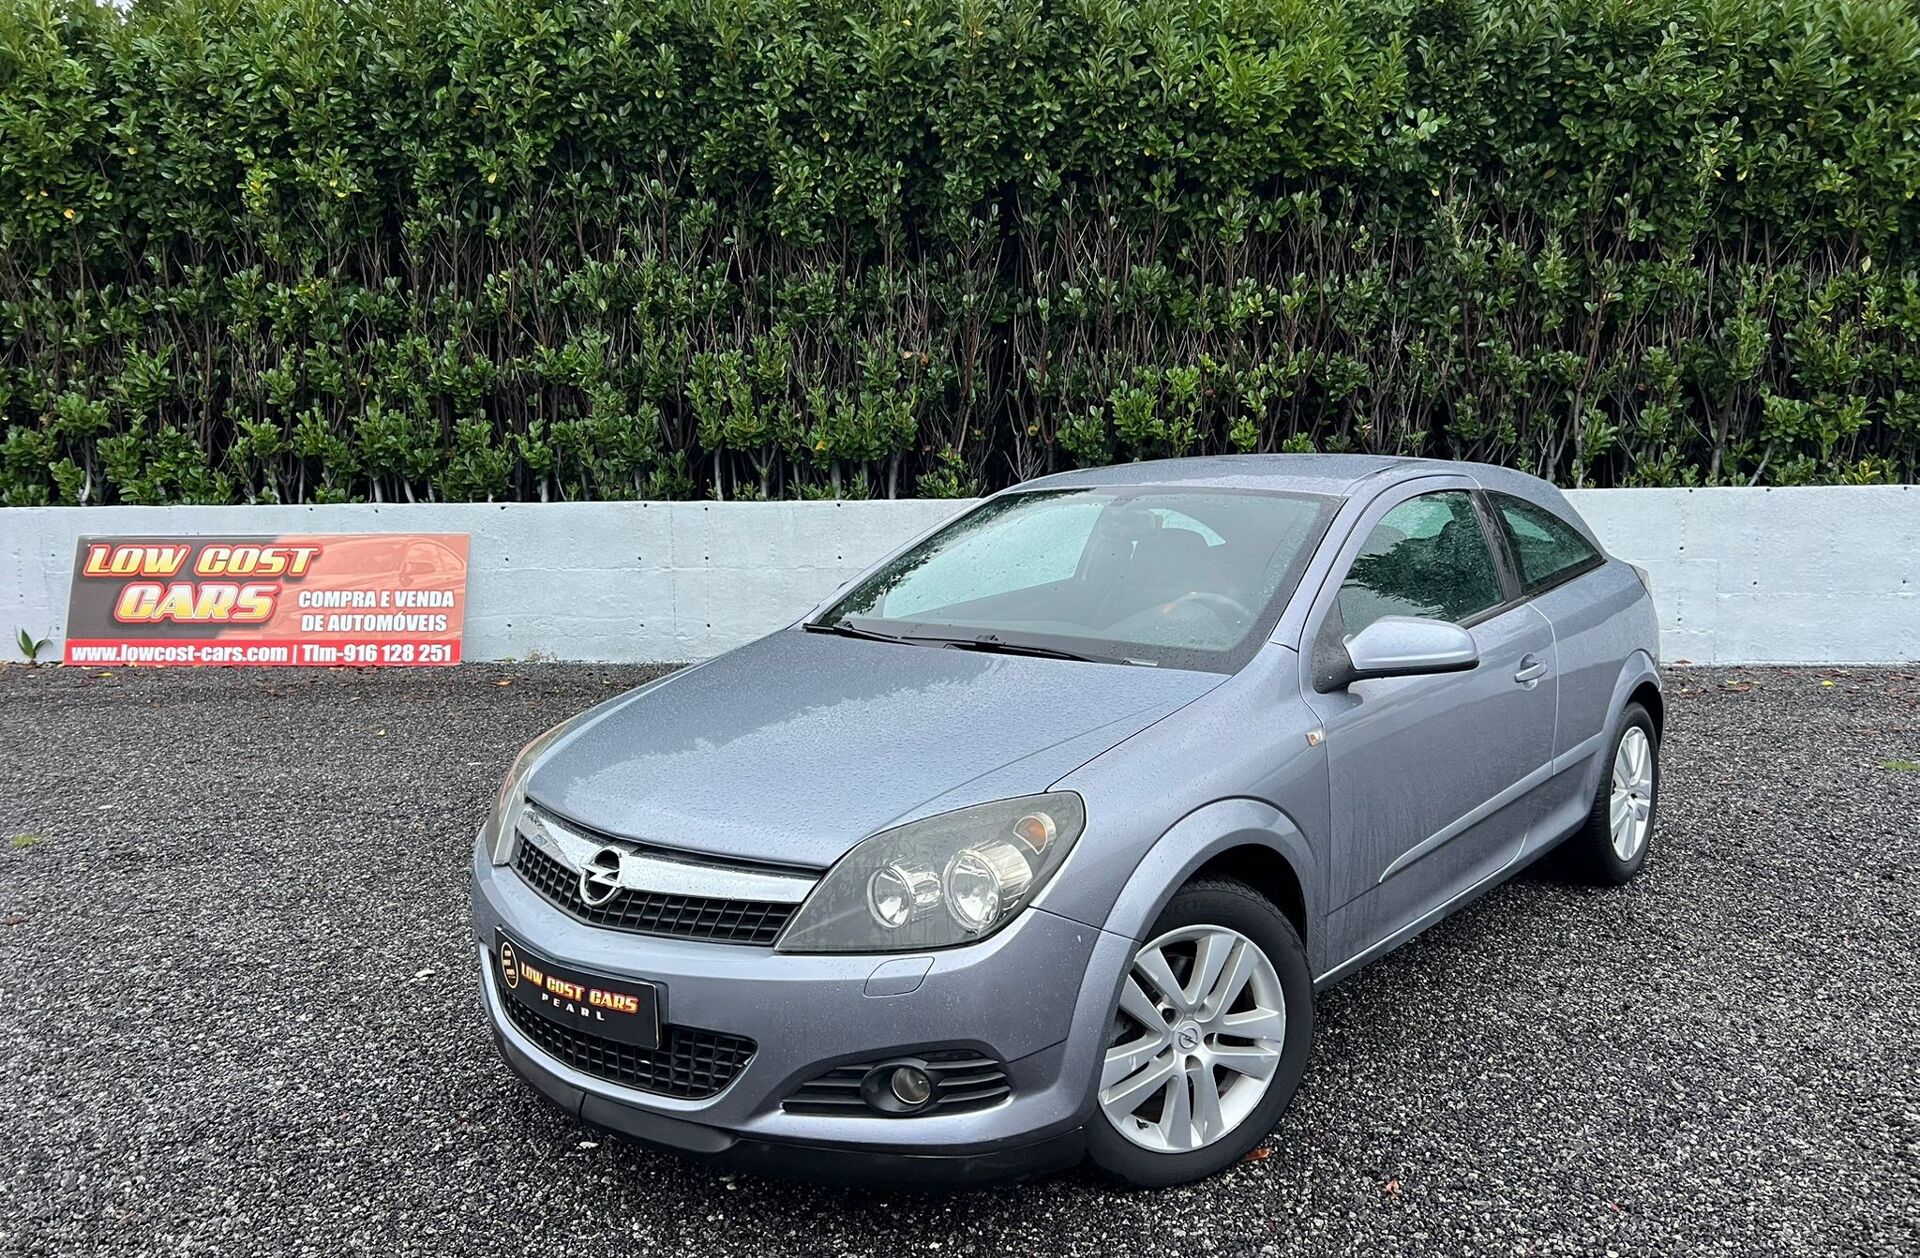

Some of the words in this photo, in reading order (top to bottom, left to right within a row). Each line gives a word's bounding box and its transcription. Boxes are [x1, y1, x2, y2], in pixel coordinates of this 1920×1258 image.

[85, 545, 190, 576] LOW
[196, 545, 320, 576] COST
[115, 582, 281, 622] CARS
[298, 590, 376, 608] COMPRA
[380, 590, 391, 608] E
[394, 590, 455, 608] VENDA
[301, 614, 324, 632] DE
[327, 611, 447, 632] AUTOMÓVEIS
[72, 644, 288, 662] www.lowcost-cars.com
[381, 644, 414, 662] 128
[418, 644, 451, 662] 251
[520, 961, 544, 987] LOW
[546, 976, 585, 1001] COST
[589, 988, 639, 1014] CARS
[542, 993, 606, 1021] PEARL
